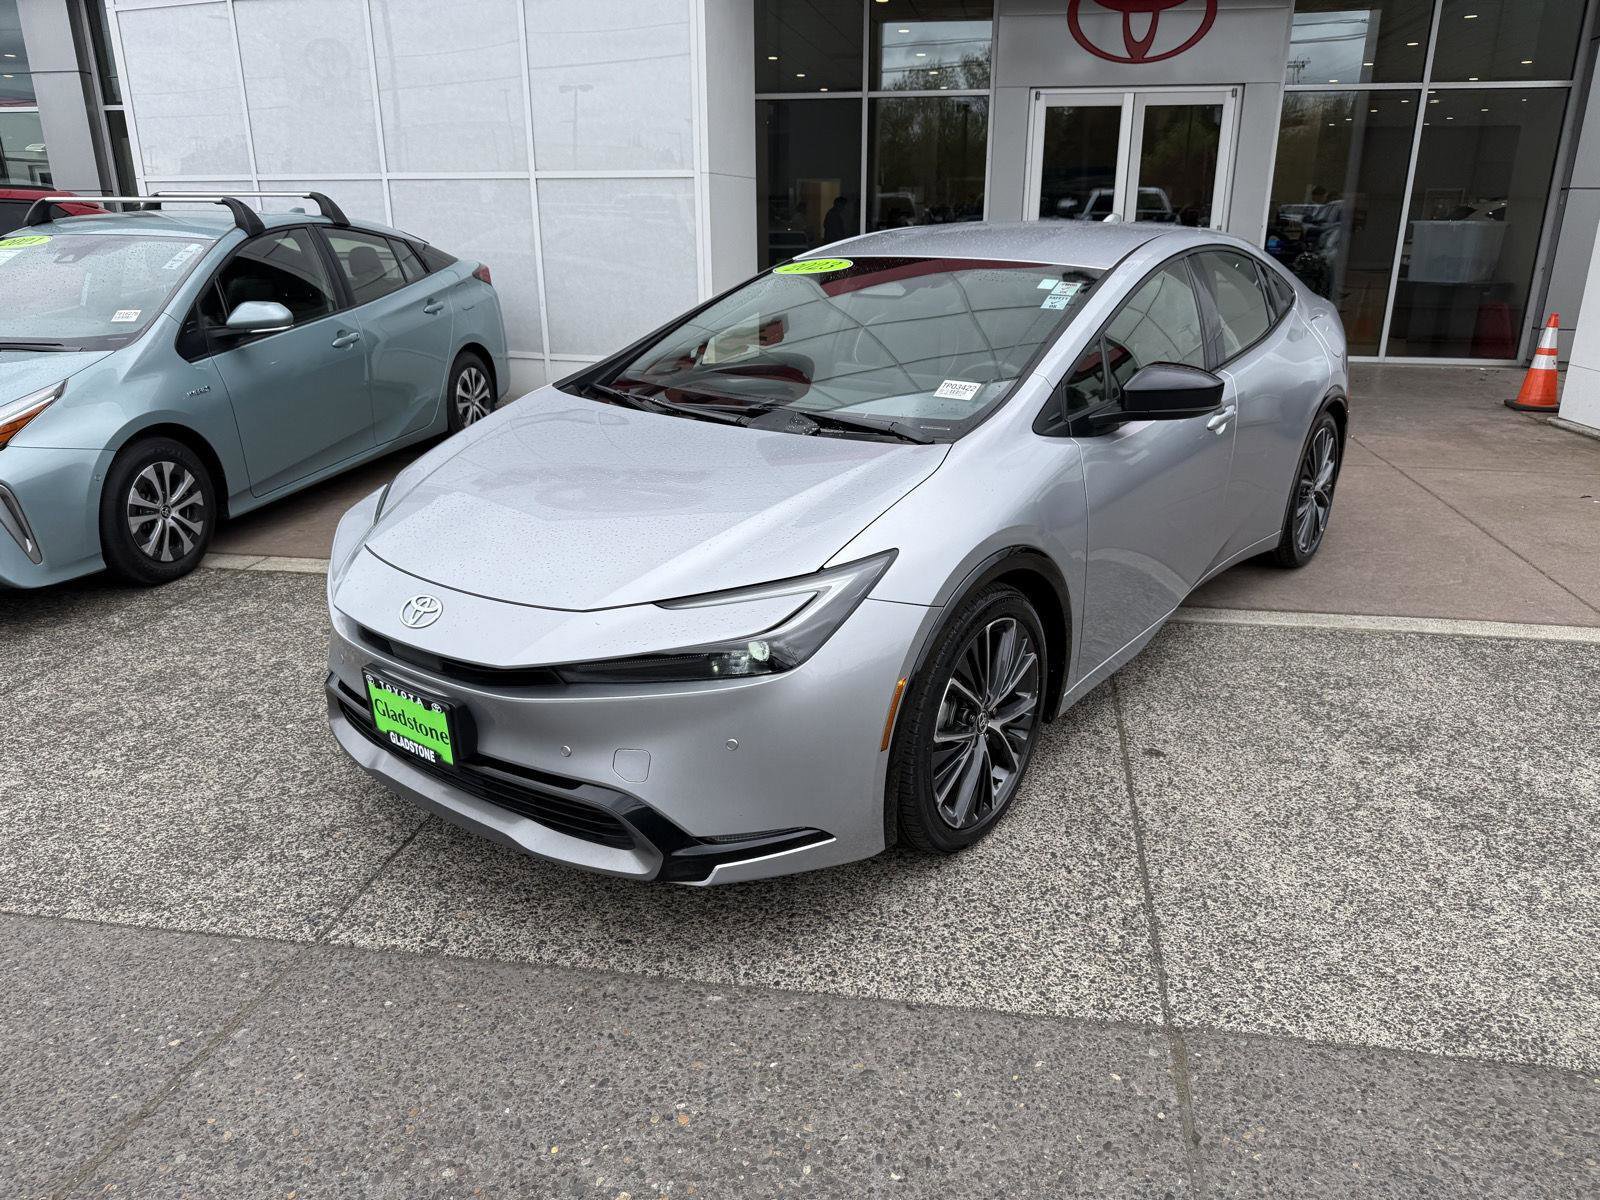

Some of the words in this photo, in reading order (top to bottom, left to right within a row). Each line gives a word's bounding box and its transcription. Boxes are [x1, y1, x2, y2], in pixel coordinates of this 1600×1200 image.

[942, 382, 977, 391] TP03422
[379, 680, 424, 706] TOYOTA
[374, 698, 450, 745] Gladstone
[389, 731, 436, 763] GLADSTONE
